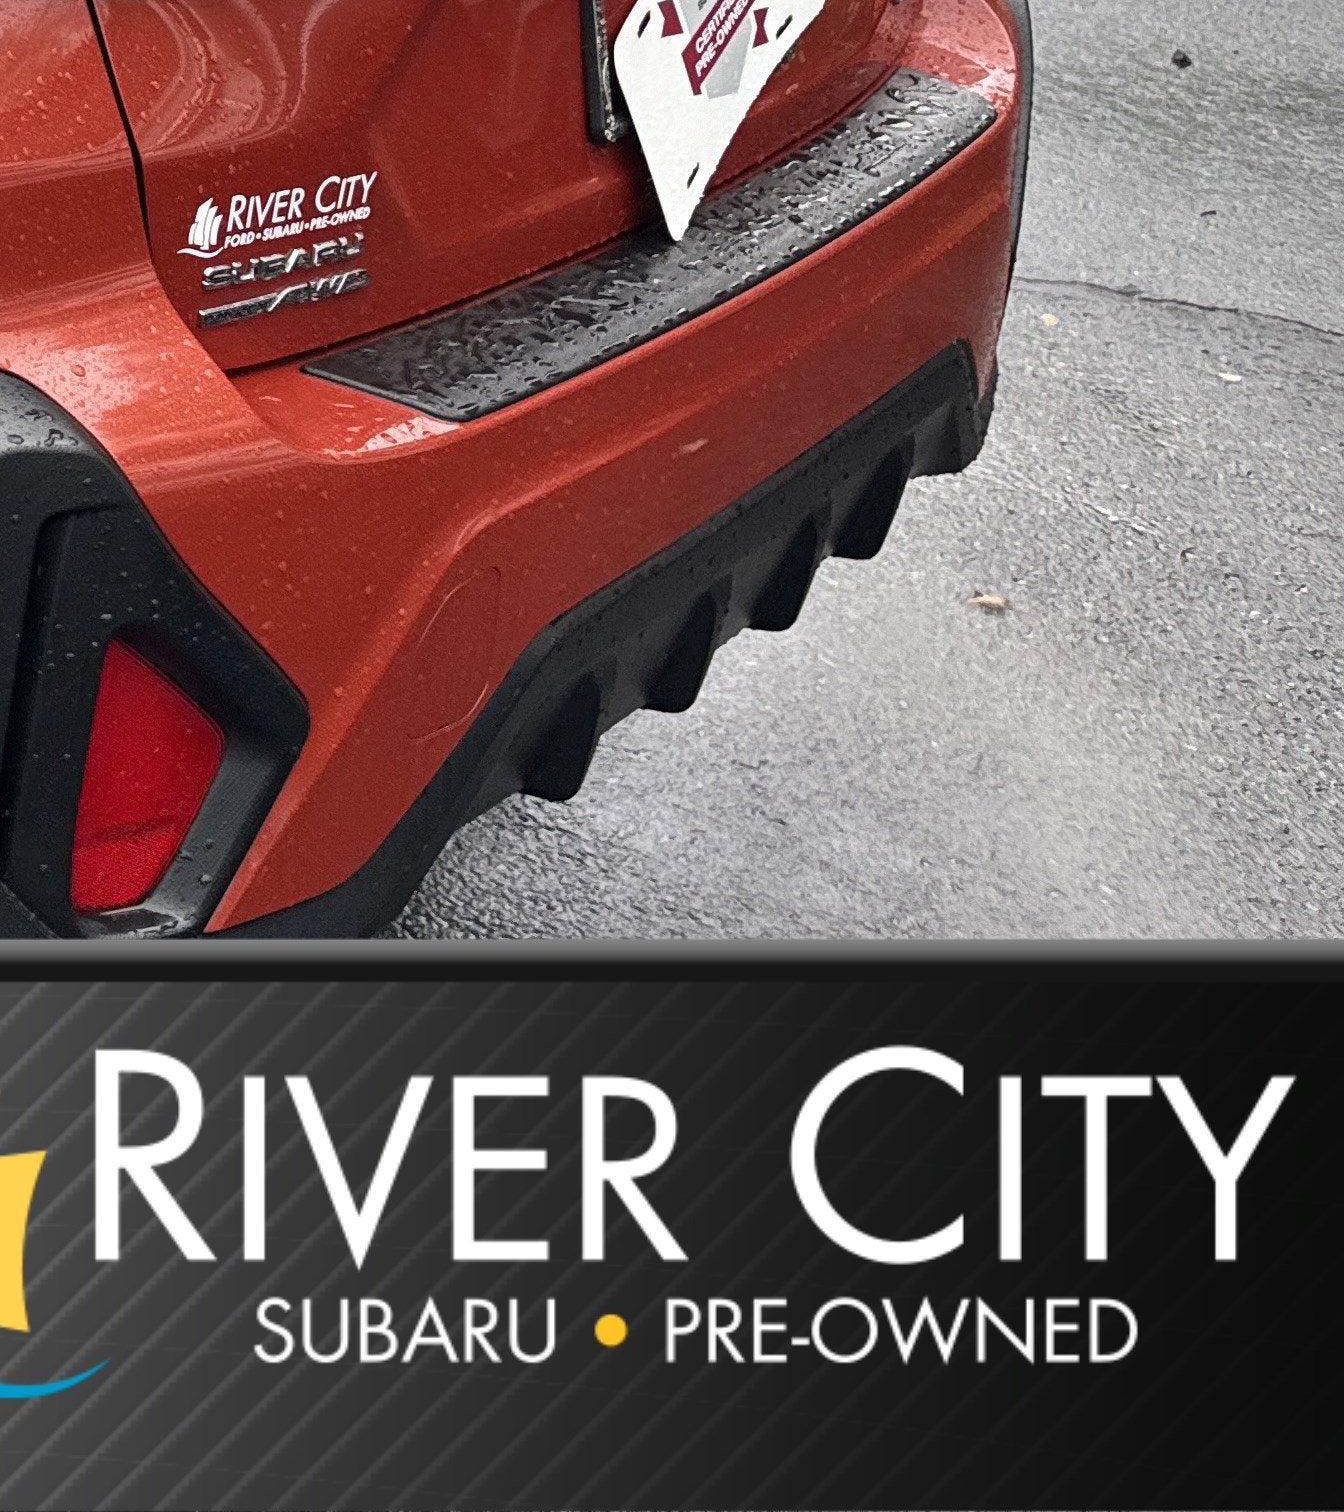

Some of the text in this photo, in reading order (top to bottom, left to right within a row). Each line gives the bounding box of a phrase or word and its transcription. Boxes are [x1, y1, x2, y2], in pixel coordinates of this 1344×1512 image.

[224, 206, 372, 249] FORD SUBARU PRE-OWNED
[226, 171, 378, 232] RIVER CITY
[201, 232, 365, 290] SUBARU
